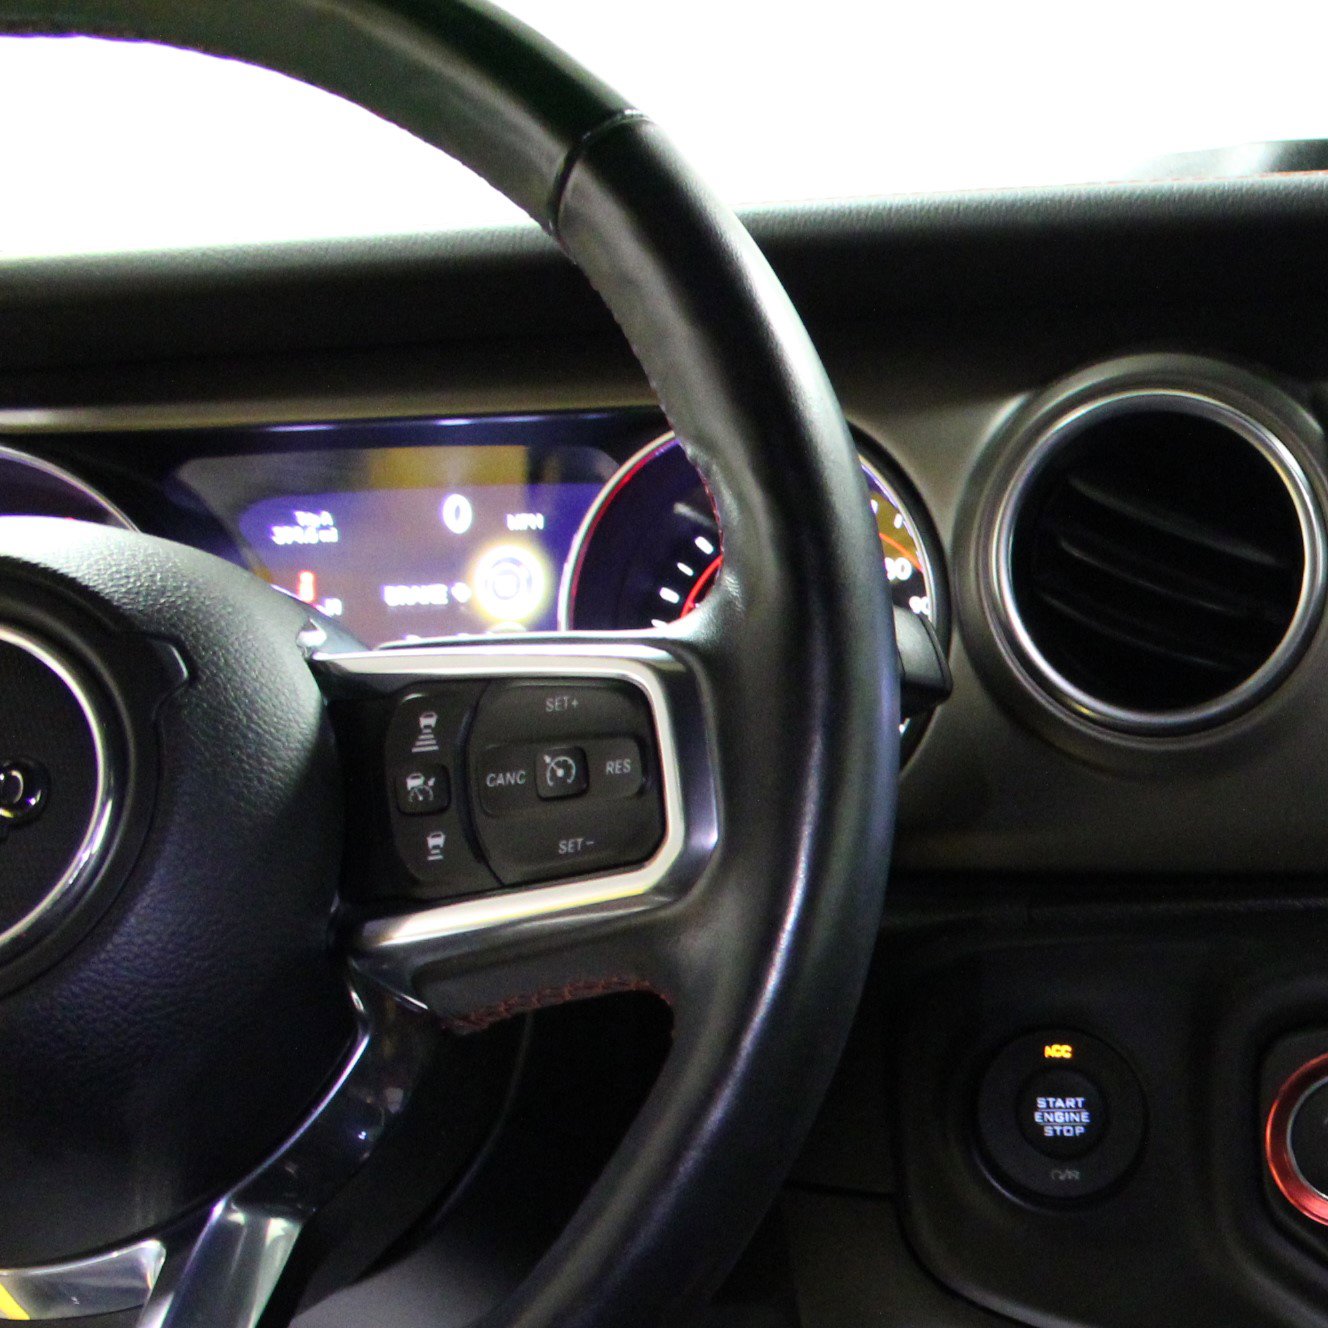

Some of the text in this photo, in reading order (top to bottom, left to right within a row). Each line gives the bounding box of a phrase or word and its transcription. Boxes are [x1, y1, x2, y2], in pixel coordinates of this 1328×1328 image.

[443, 493, 473, 534] 0
[605, 759, 632, 775] RES
[486, 770, 527, 788] CANC
[1036, 1097, 1085, 1109] START
[1034, 1111, 1090, 1123] ENGINE
[1043, 1125, 1085, 1137] STOP
